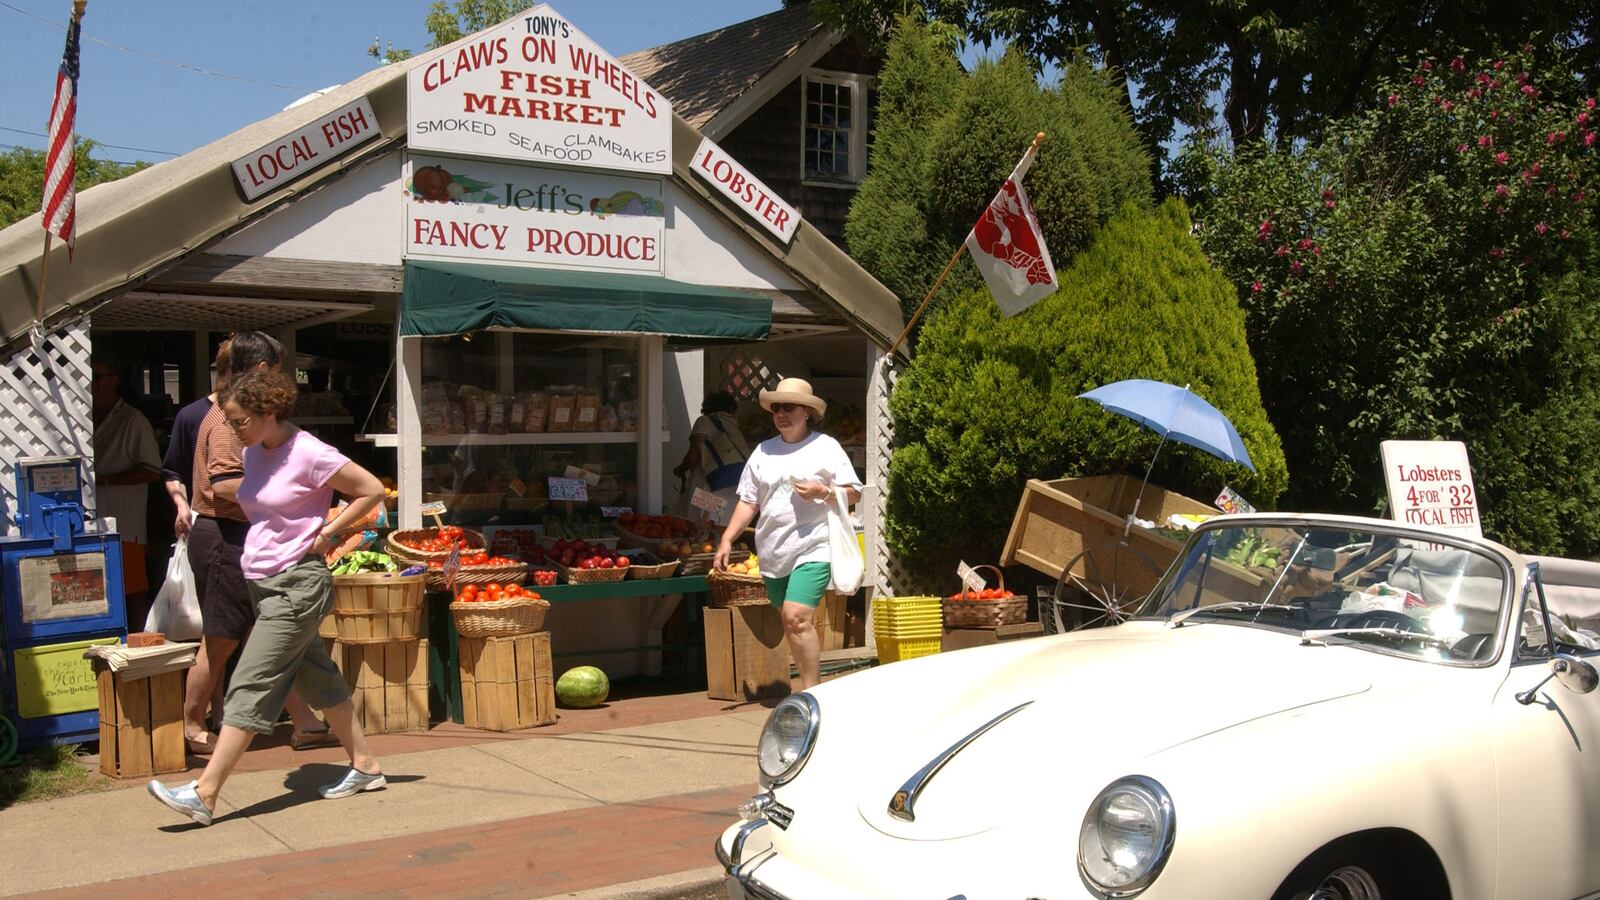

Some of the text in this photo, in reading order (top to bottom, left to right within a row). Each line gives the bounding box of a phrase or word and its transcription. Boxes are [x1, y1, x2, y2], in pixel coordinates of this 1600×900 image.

[525, 16, 570, 39] TONY'S
[423, 36, 657, 119] CLAWS ON WHEELS
[500, 70, 591, 99] FISH
[463, 92, 625, 127] MARKET
[245, 106, 369, 187] LOCAL FISH
[416, 119, 592, 161] SMOKED SEAFOOD
[563, 134, 666, 163] CLAMBAKES
[497, 183, 583, 215] Jeff's
[701, 149, 790, 232] LOBSTER
[413, 218, 656, 261] FANCY PRODUCE
[1398, 465, 1461, 481] Lobsters
[1407, 485, 1419, 506] 4
[1419, 490, 1440, 503] FOR
[1450, 507, 1474, 525] FISH
